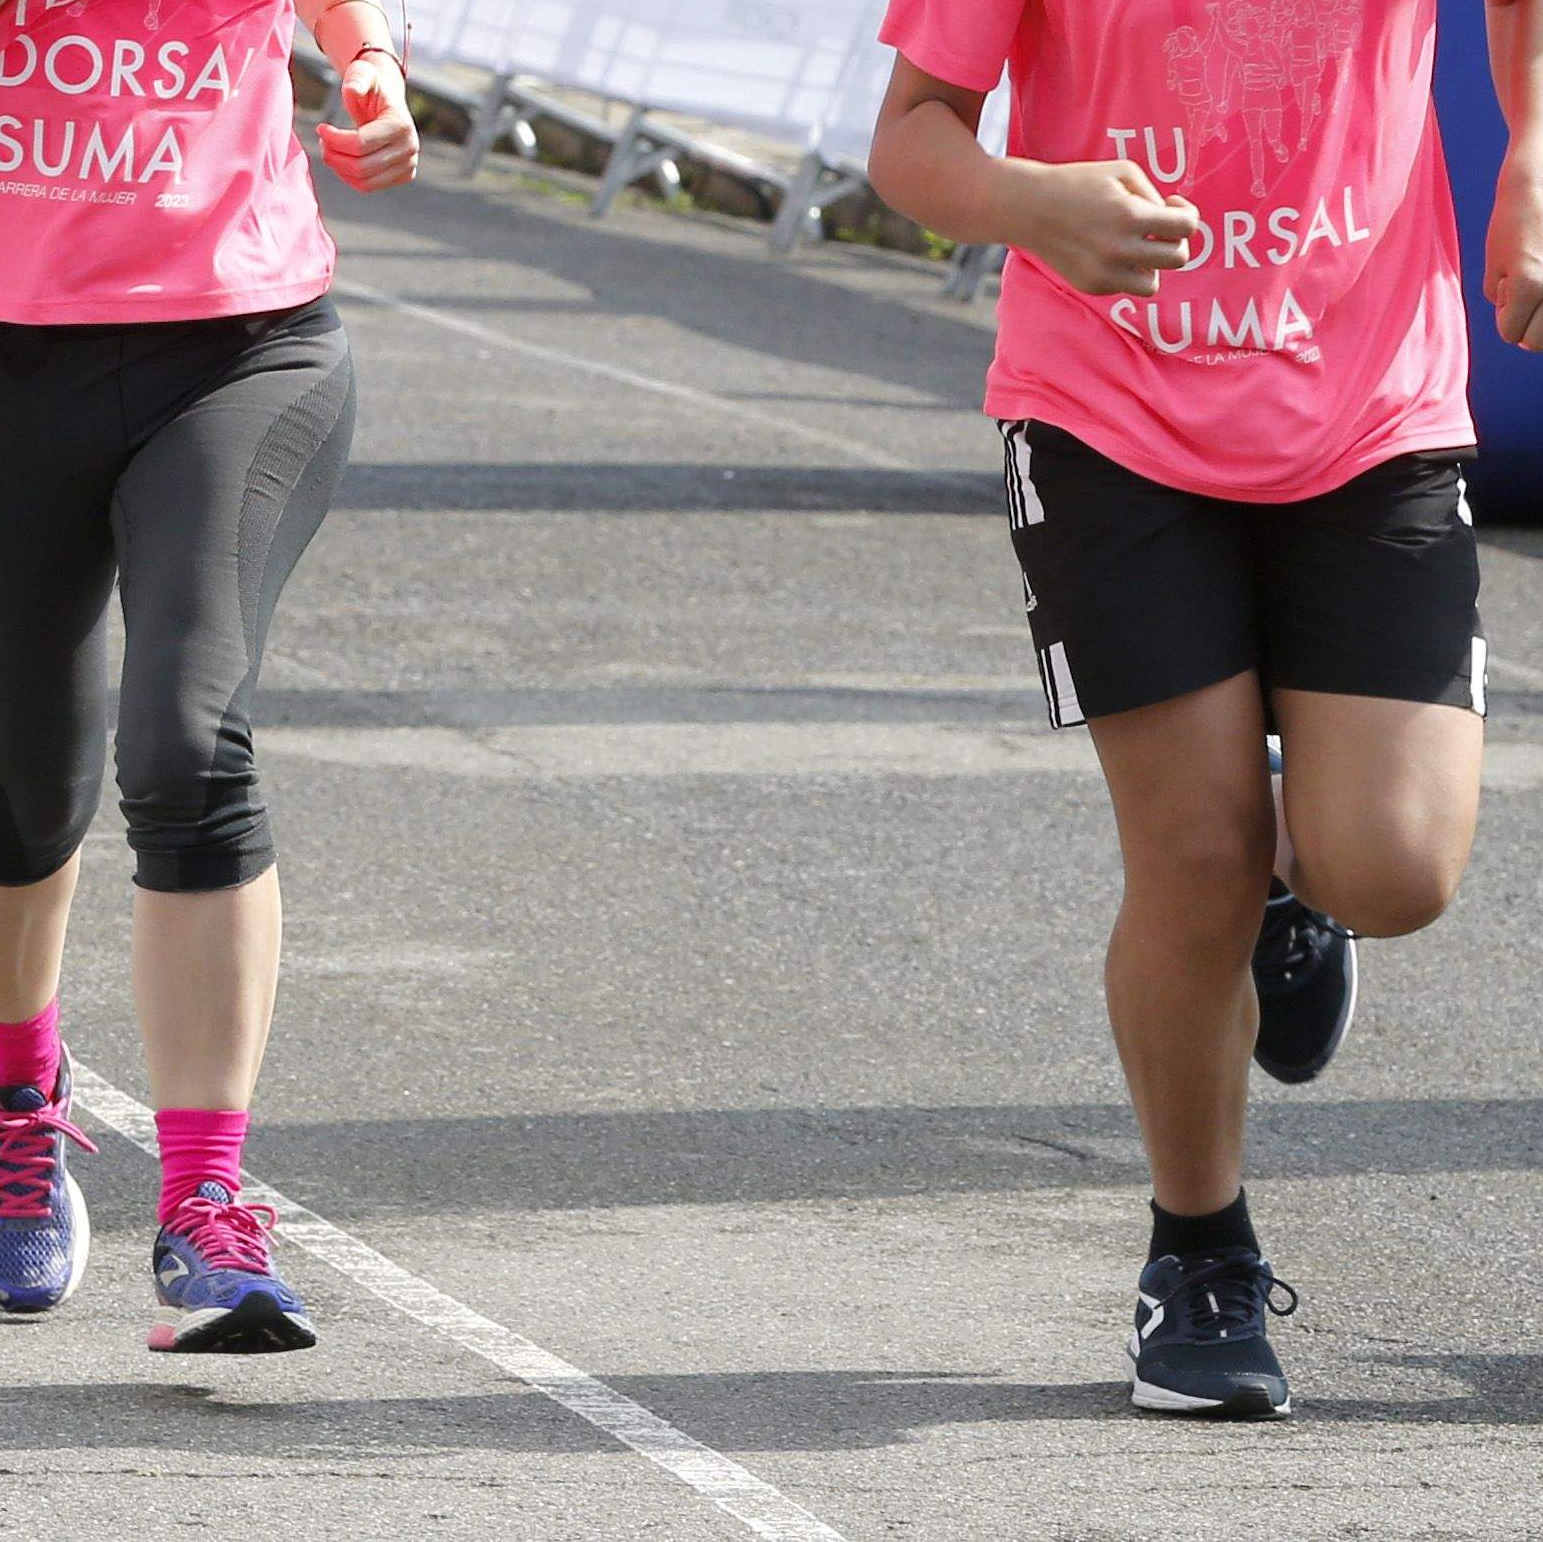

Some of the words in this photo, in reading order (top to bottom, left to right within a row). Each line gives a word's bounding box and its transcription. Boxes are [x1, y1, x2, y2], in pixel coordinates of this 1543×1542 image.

[1106, 126, 1188, 184] TU
[49, 187, 67, 201] DE
[71, 189, 87, 202] LA
[89, 189, 138, 206] MUJER
[153, 193, 191, 208] 2023
[1174, 185, 1371, 273] ORSAL
[1109, 287, 1314, 355] SUMA
